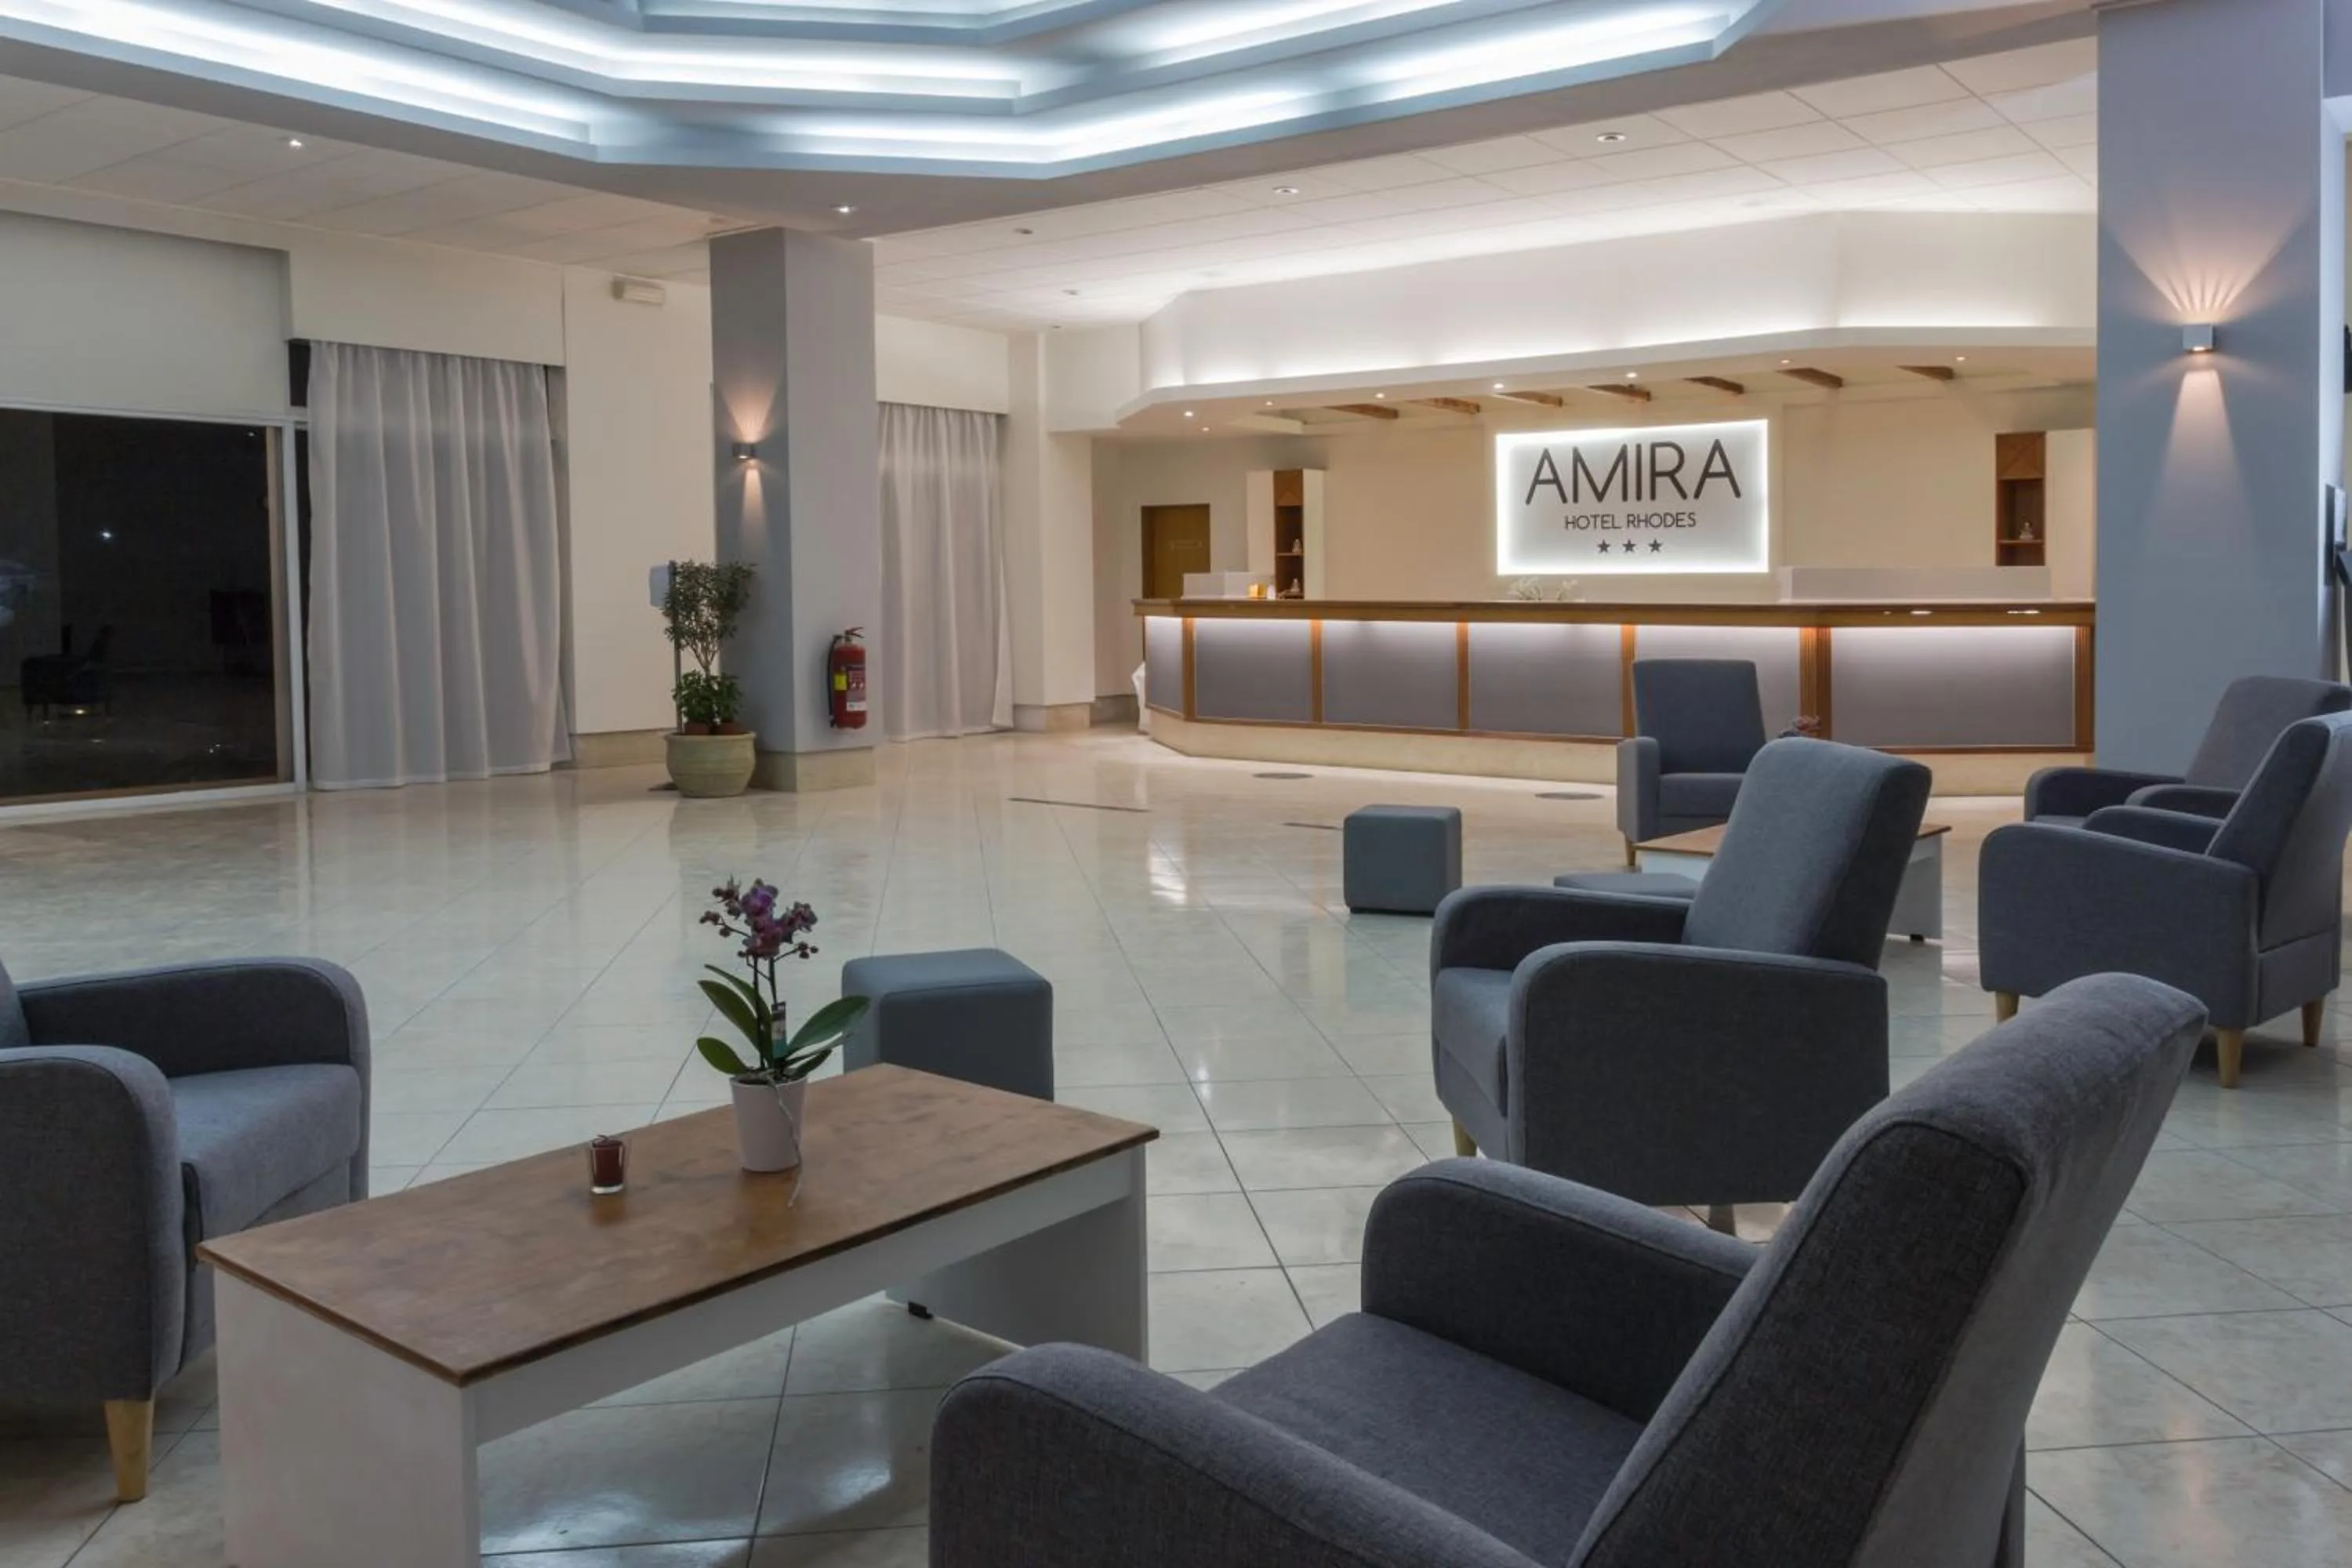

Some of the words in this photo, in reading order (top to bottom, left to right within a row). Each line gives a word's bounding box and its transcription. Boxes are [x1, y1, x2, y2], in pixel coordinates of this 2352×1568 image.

[1525, 438, 1741, 505] AMIRA
[1565, 514, 1621, 531] HOTEL
[1627, 512, 1697, 529] RHODES
